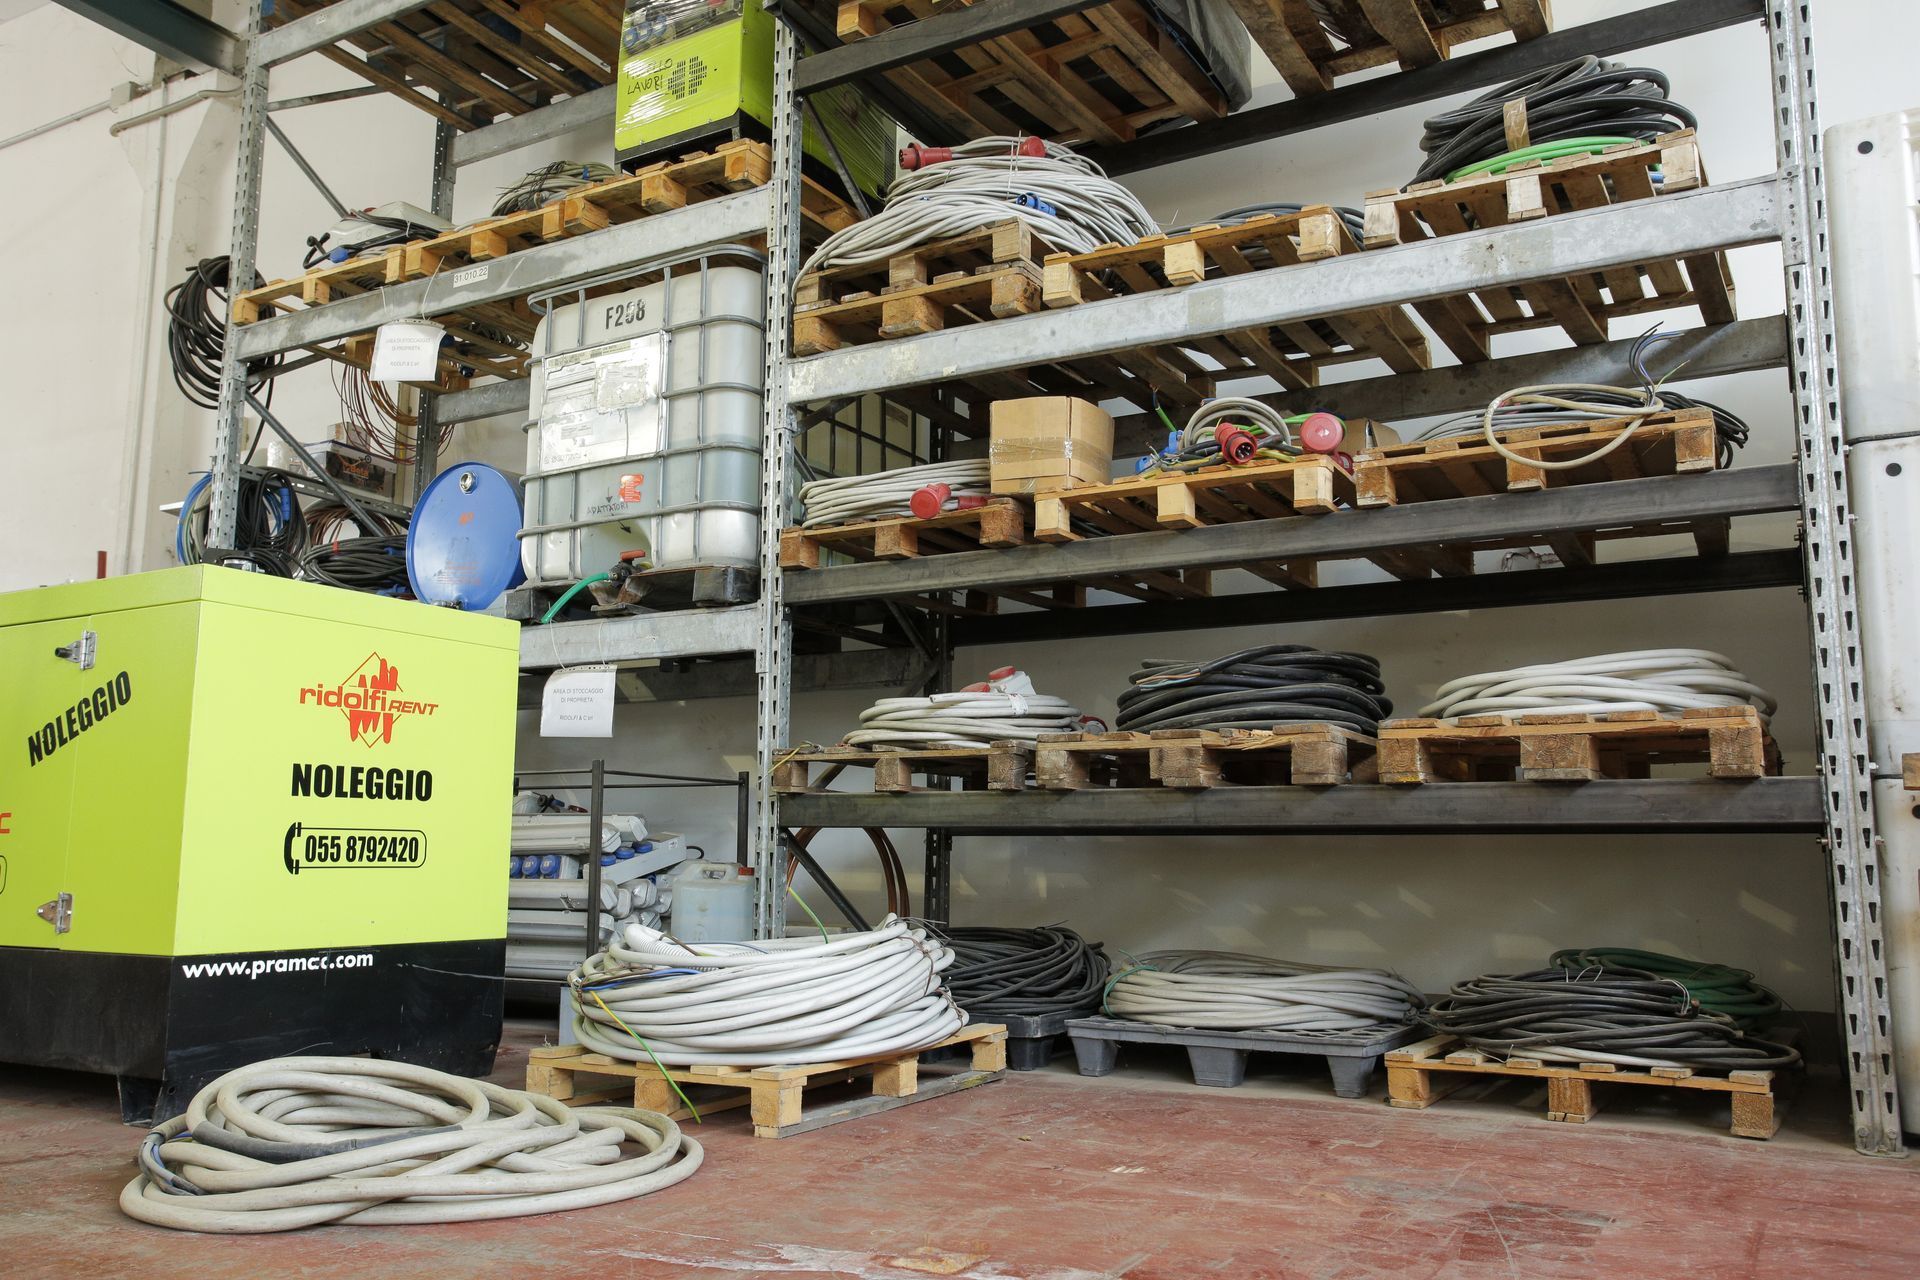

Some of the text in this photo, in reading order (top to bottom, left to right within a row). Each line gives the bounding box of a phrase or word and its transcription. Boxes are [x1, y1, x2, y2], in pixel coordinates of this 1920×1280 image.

[299, 684, 439, 715] ridolfi RENT
[28, 671, 131, 767] NOLEGGIO
[291, 763, 433, 801] NOLEGGIO
[305, 835, 419, 862] 055 8792420
